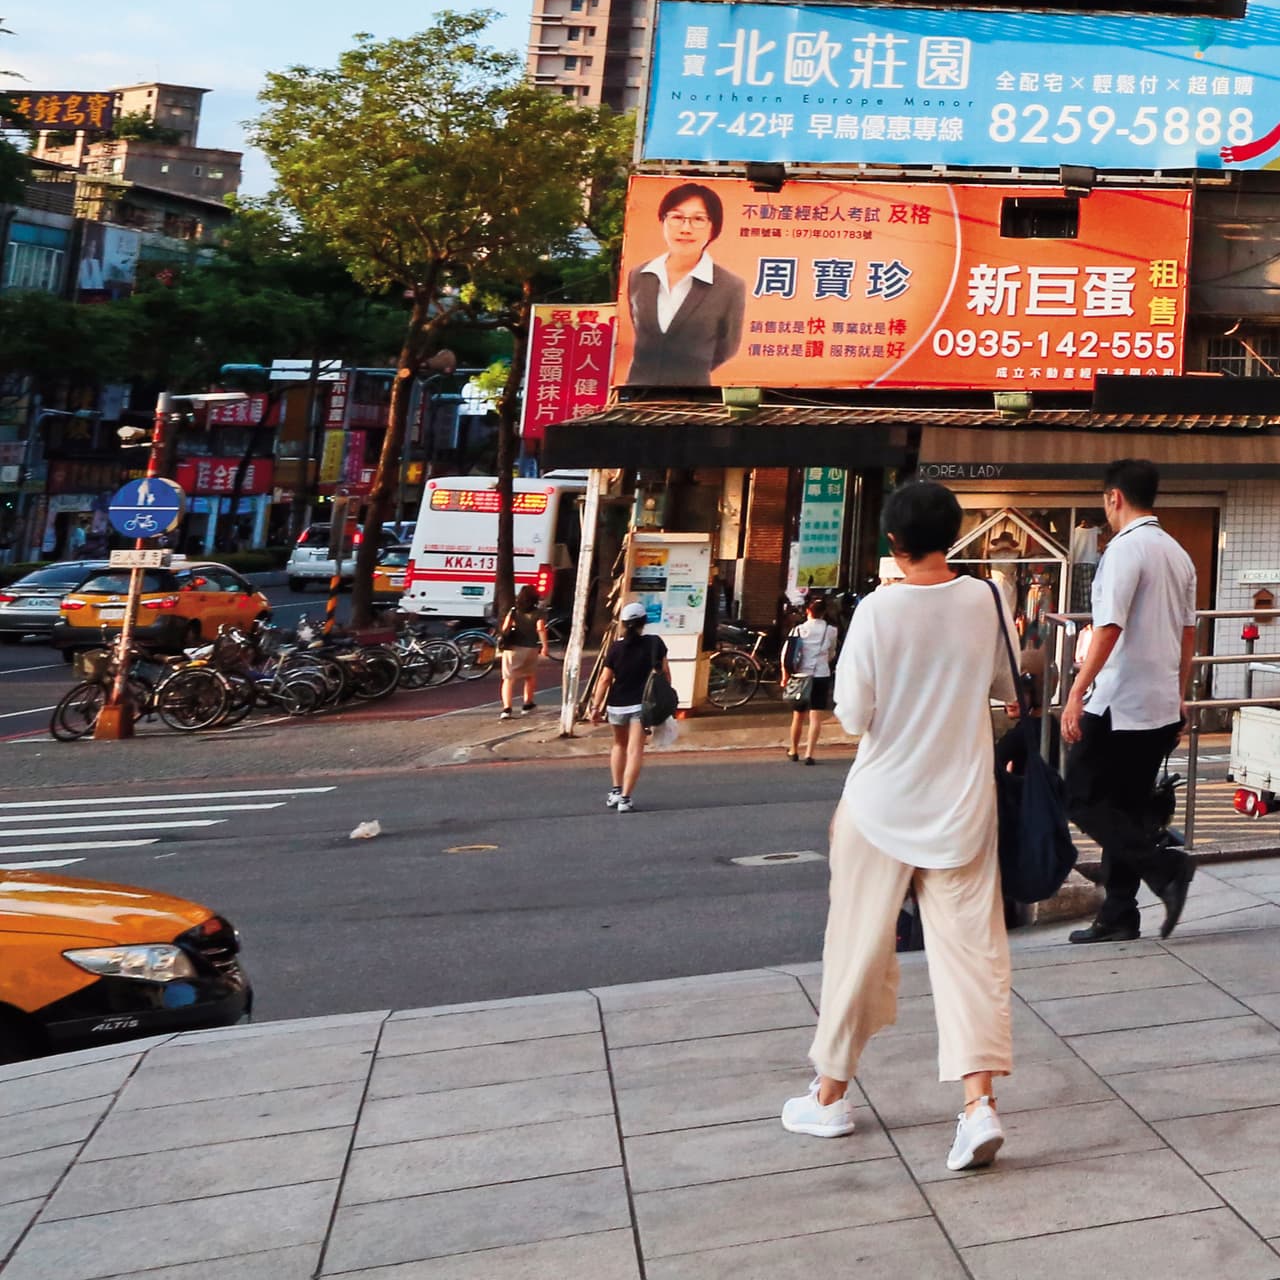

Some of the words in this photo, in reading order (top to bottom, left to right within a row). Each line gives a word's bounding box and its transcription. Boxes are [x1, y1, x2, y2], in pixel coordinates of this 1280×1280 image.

[681, 26, 709, 77] 麗寶
[714, 28, 972, 91] 北歐莊園
[671, 91, 784, 104] Northern
[803, 94, 883, 108] Europe
[904, 97, 976, 108] Manor
[676, 111, 794, 138] 27-42坪
[808, 114, 963, 142] 早鳥優惠專線
[988, 102, 1254, 146] 8259-5888
[742, 204, 881, 222] 不動產經紀人考試
[888, 204, 932, 224] 及格
[752, 256, 912, 301] 周寶珍
[966, 264, 1137, 318] 新巨蛋
[1147, 259, 1179, 327] 租售
[750, 317, 826, 335] 銷售就是快
[830, 341, 905, 359] 服務就是好
[932, 327, 1176, 359] 0935-142-555
[534, 328, 567, 421] 子宮頸抹片
[919, 465, 965, 478] KOREA
[970, 465, 1004, 478] LADY
[445, 556, 499, 570] KKA-13
[91, 1019, 138, 1031] ALTIS
